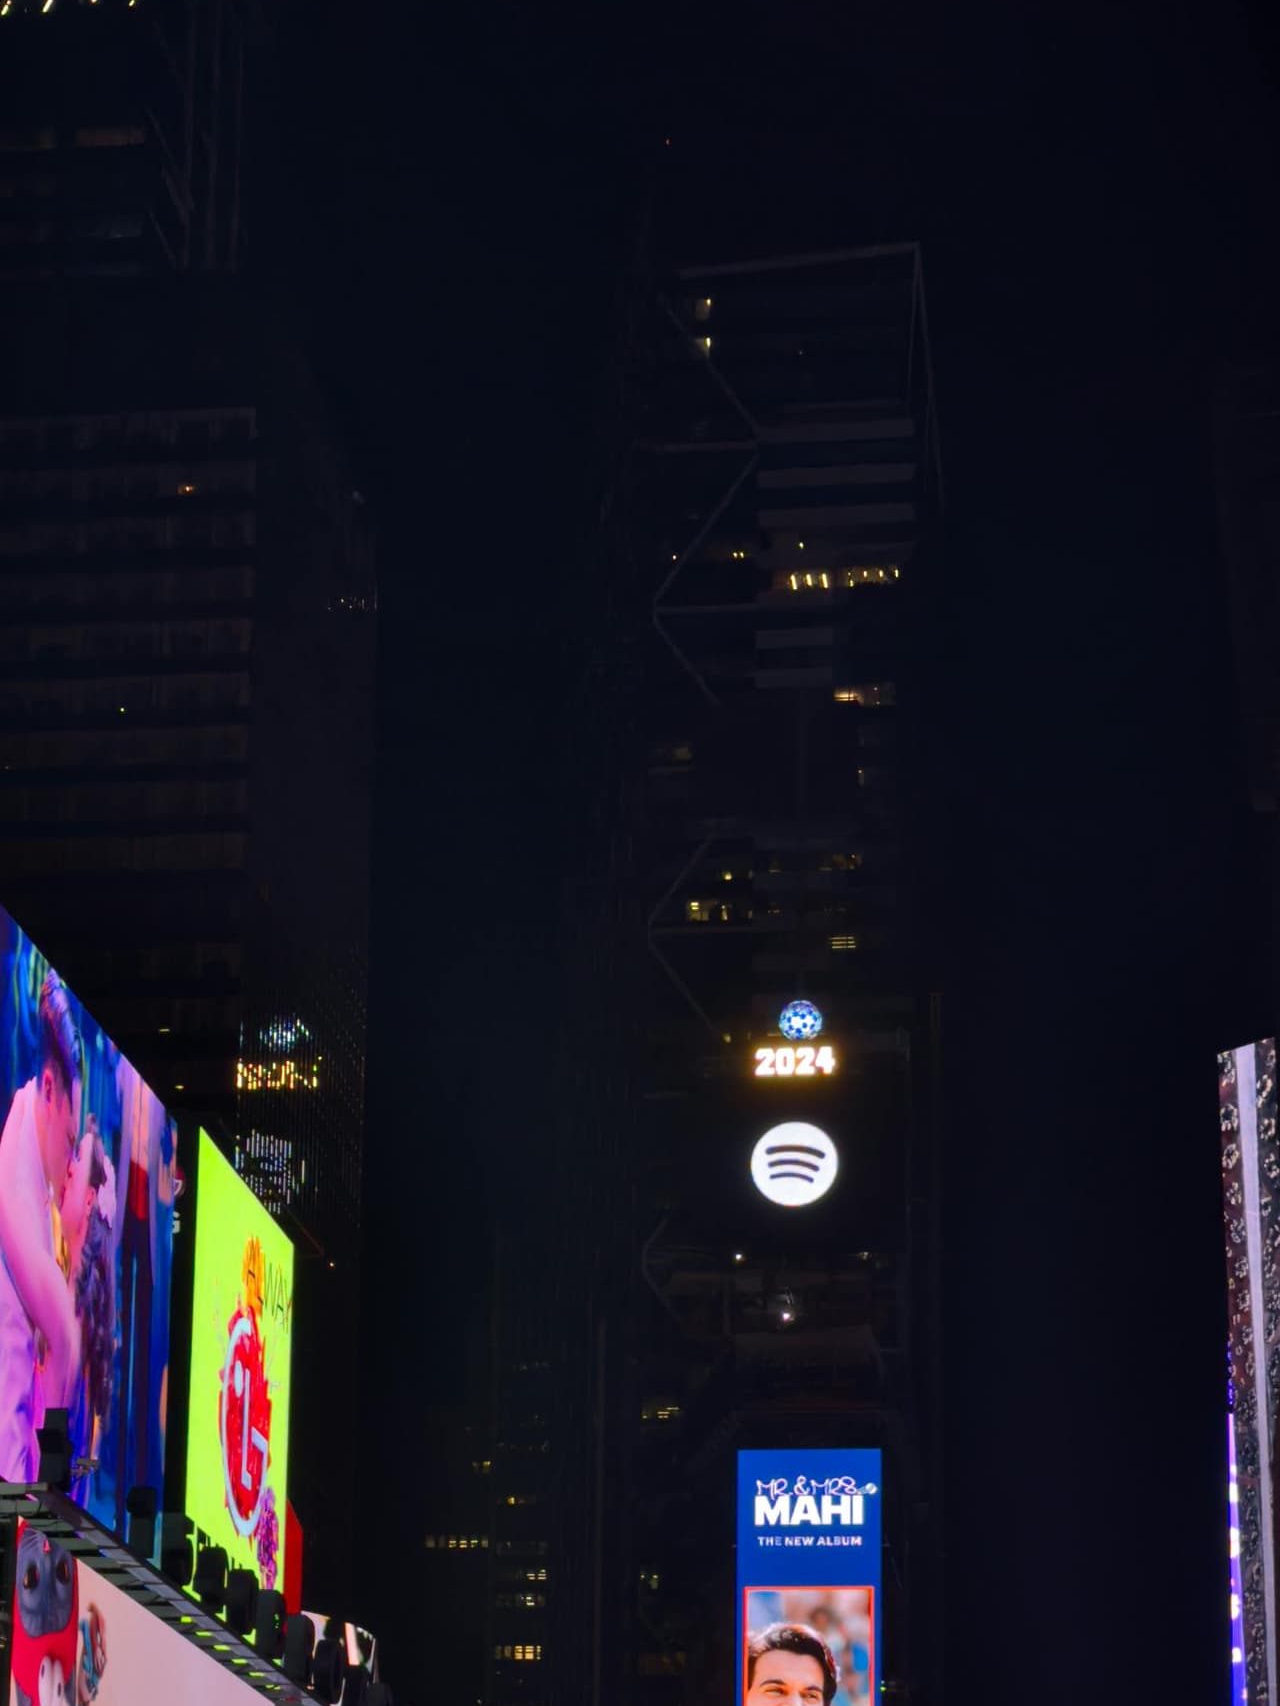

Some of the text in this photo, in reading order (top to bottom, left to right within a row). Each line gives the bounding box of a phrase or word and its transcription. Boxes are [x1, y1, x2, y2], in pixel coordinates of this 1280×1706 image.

[754, 1045, 838, 1077] 2024
[754, 1494, 864, 1526] MAHI
[757, 1535, 863, 1547] THE NEW ALBUM
